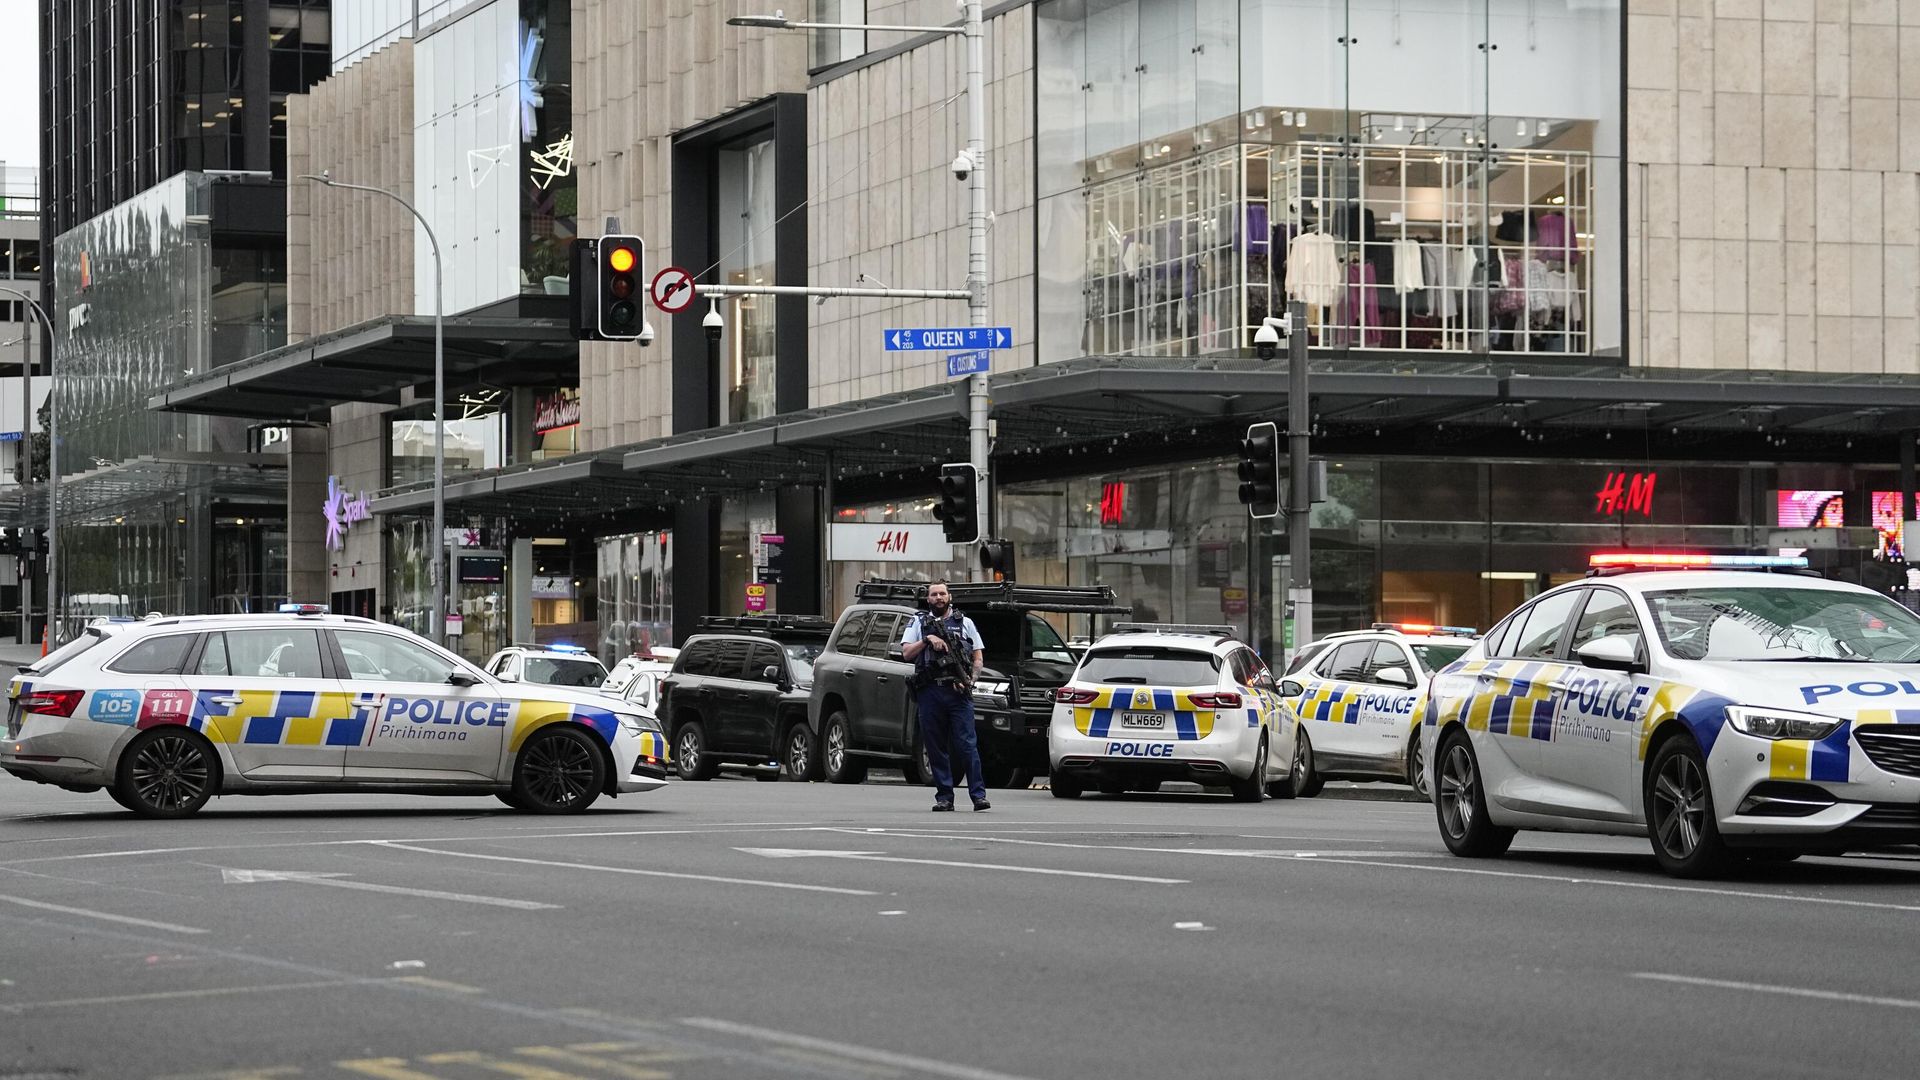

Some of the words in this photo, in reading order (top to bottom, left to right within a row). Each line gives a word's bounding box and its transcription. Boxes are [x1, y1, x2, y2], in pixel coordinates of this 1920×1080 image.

[902, 342, 914, 350] 203
[922, 331, 964, 346] QUEEN
[968, 331, 977, 339] ST
[956, 355, 977, 373] CUSTOMS
[1100, 482, 1124, 525] H&M
[1595, 472, 1657, 517] H&M
[342, 491, 367, 529] Spark
[876, 530, 910, 554] H&M
[99, 699, 133, 714] 105
[151, 699, 184, 713] 111
[1364, 694, 1417, 714] POLICE
[1563, 678, 1650, 722] POLICE
[384, 698, 511, 727] POLICE
[1123, 714, 1163, 726] MLW669
[379, 725, 468, 741] Pirihimana
[1559, 715, 1611, 742] Pirihimana
[1109, 742, 1175, 757] POLICE
